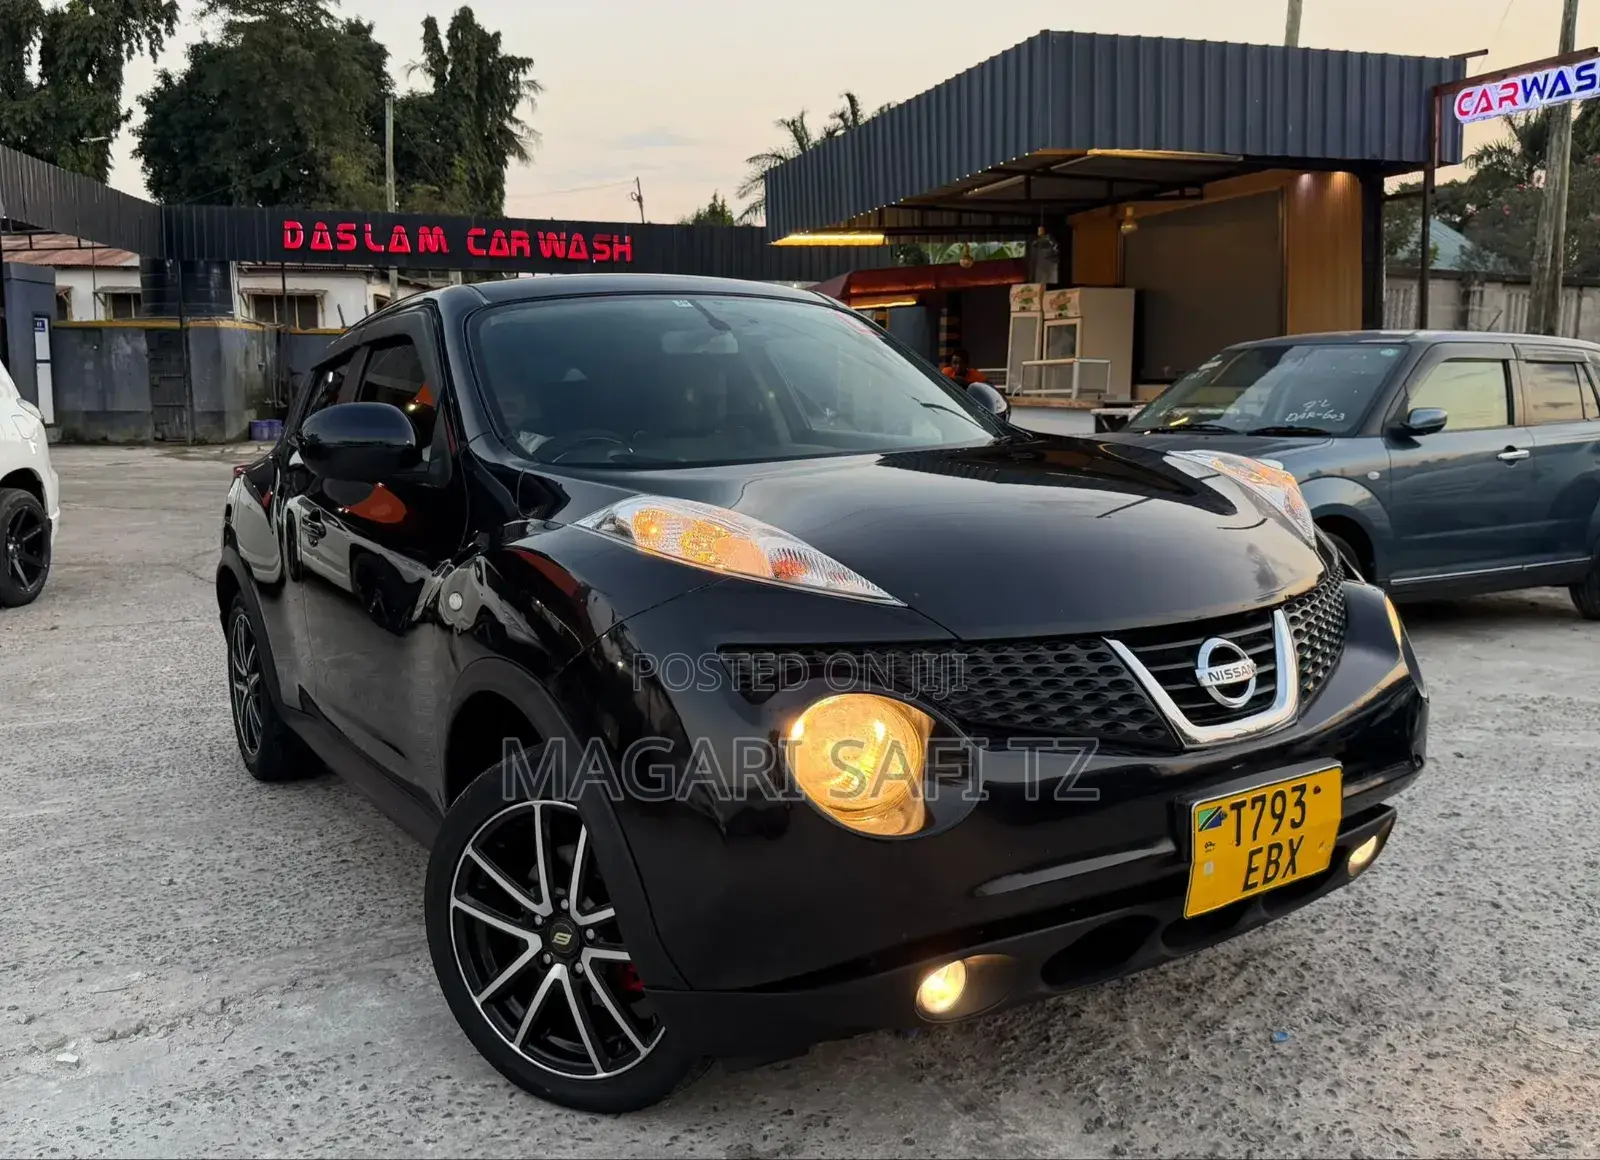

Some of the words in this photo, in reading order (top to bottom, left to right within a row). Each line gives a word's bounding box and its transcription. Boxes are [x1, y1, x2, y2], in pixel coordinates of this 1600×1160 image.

[1457, 62, 1600, 117] CARWAS
[283, 220, 450, 253] DASLAM
[467, 227, 531, 259] CAR
[537, 231, 633, 263] WASH
[1207, 664, 1256, 682] NISSAN
[1230, 783, 1307, 847] T793
[1242, 835, 1304, 892] EBX
